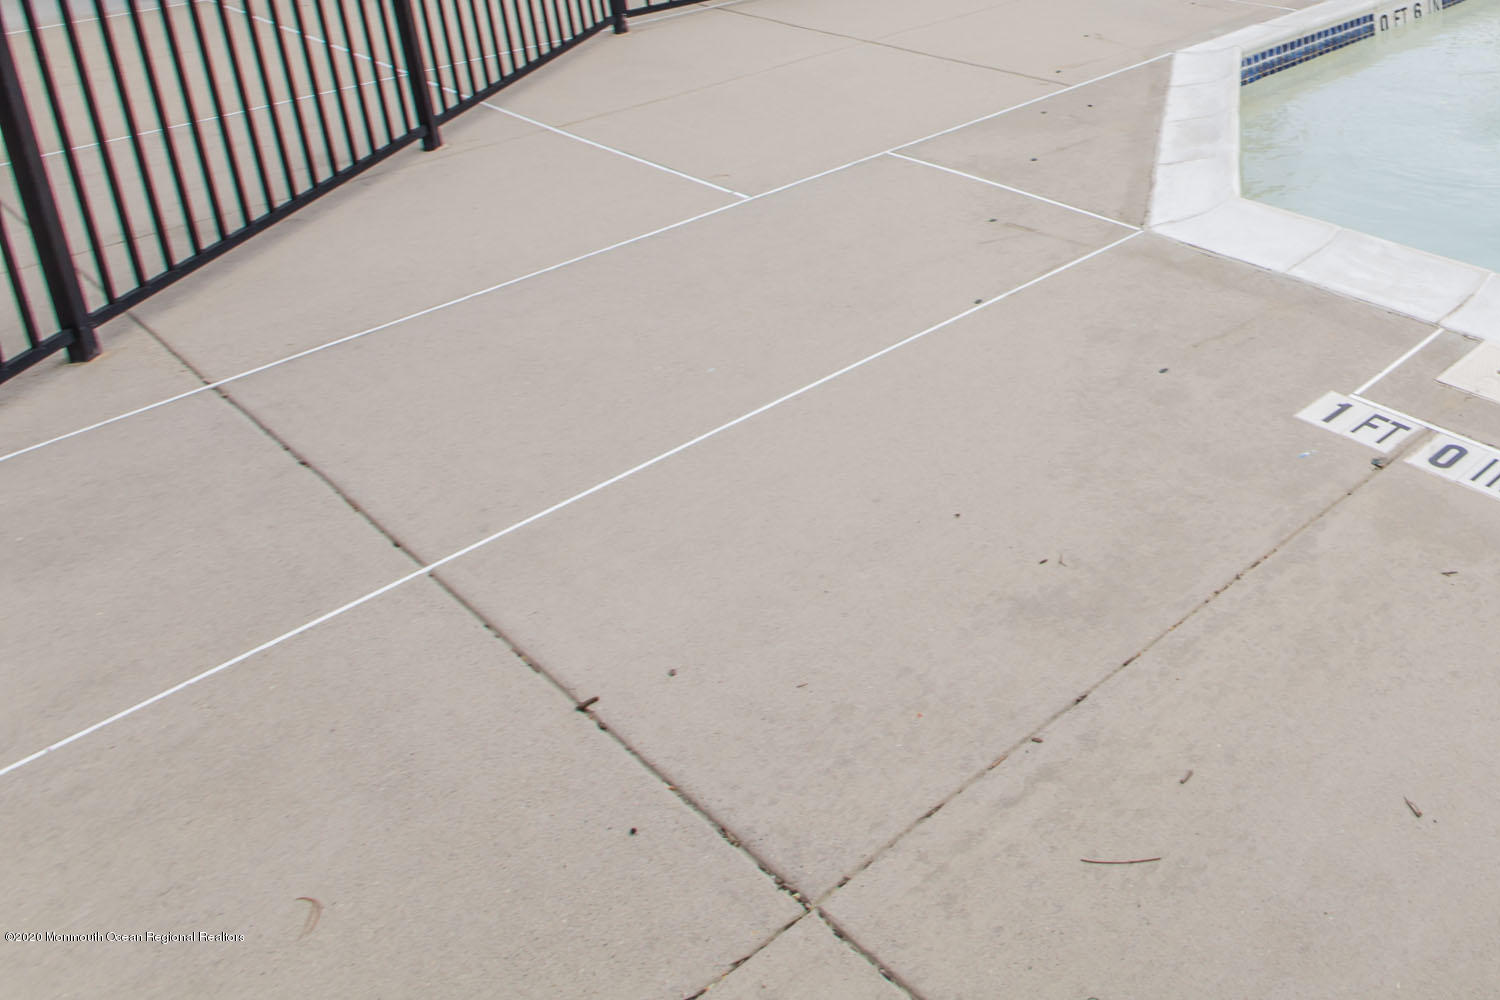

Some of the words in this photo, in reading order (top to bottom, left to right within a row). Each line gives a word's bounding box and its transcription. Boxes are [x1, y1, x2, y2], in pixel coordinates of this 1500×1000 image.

[1394, 6, 1407, 28] FT
[1414, 2, 1422, 19] 6
[1322, 402, 1353, 424] 1
[1350, 413, 1412, 445] FT
[1428, 443, 1468, 469] 0
